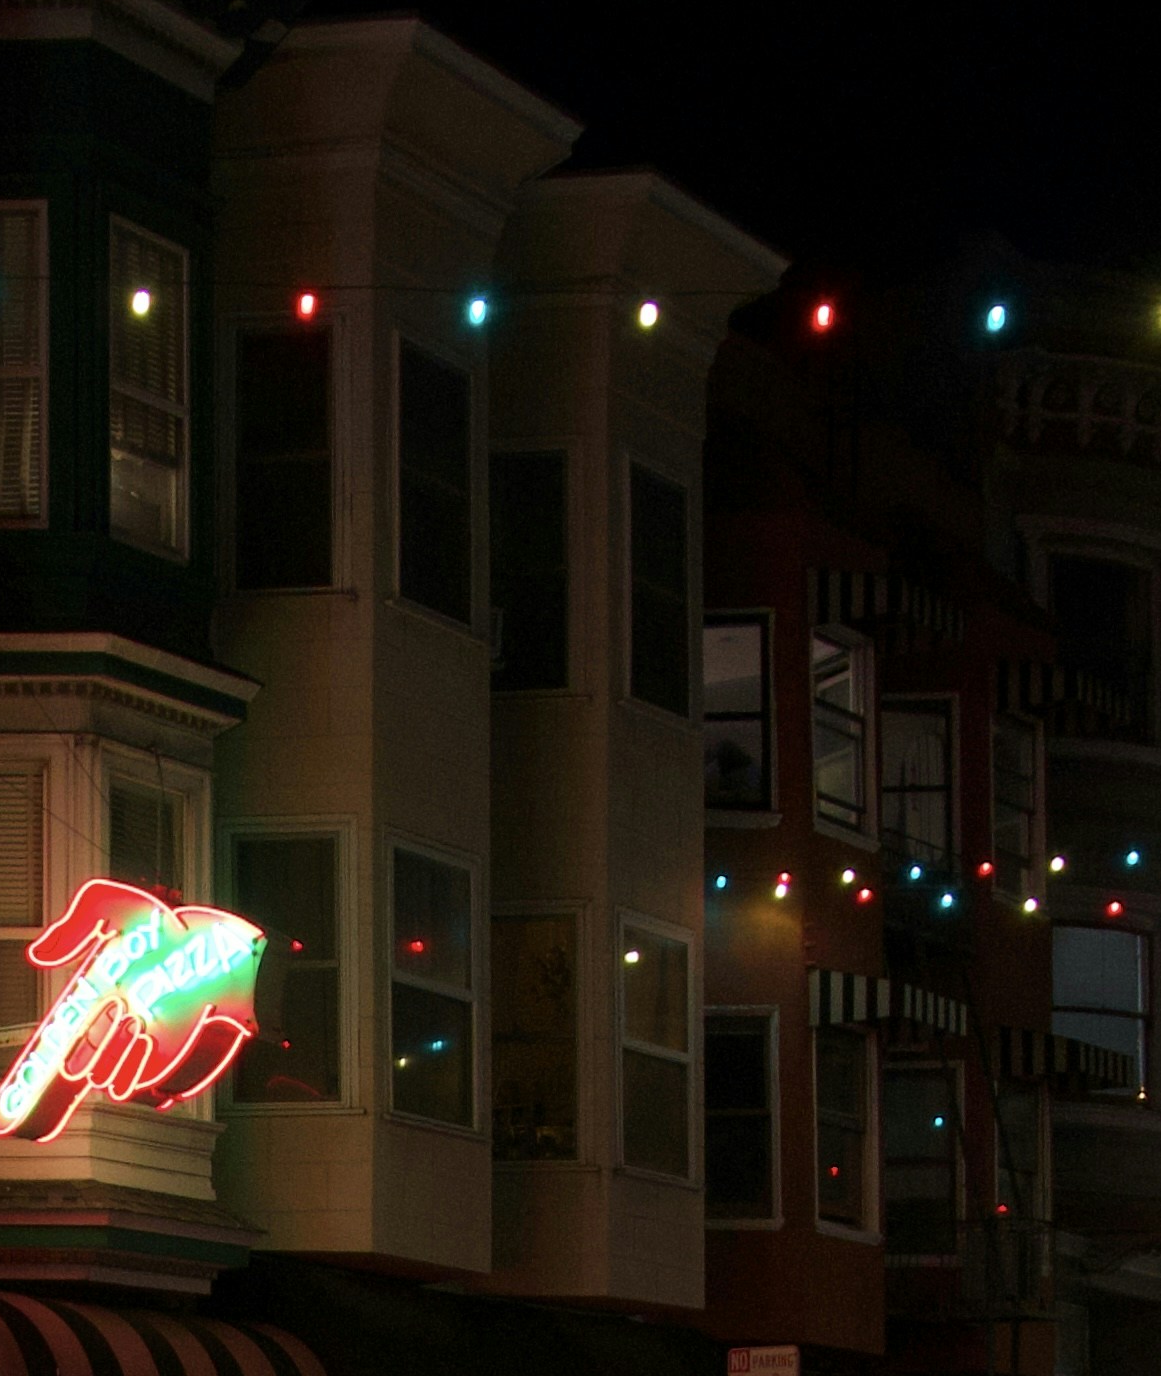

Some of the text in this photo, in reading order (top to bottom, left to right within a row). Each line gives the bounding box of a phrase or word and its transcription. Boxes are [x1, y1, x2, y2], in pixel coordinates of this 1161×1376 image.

[92, 908, 162, 986] BOY
[126, 920, 252, 1026] PIZZA
[730, 1351, 794, 1371] NO PARKING
